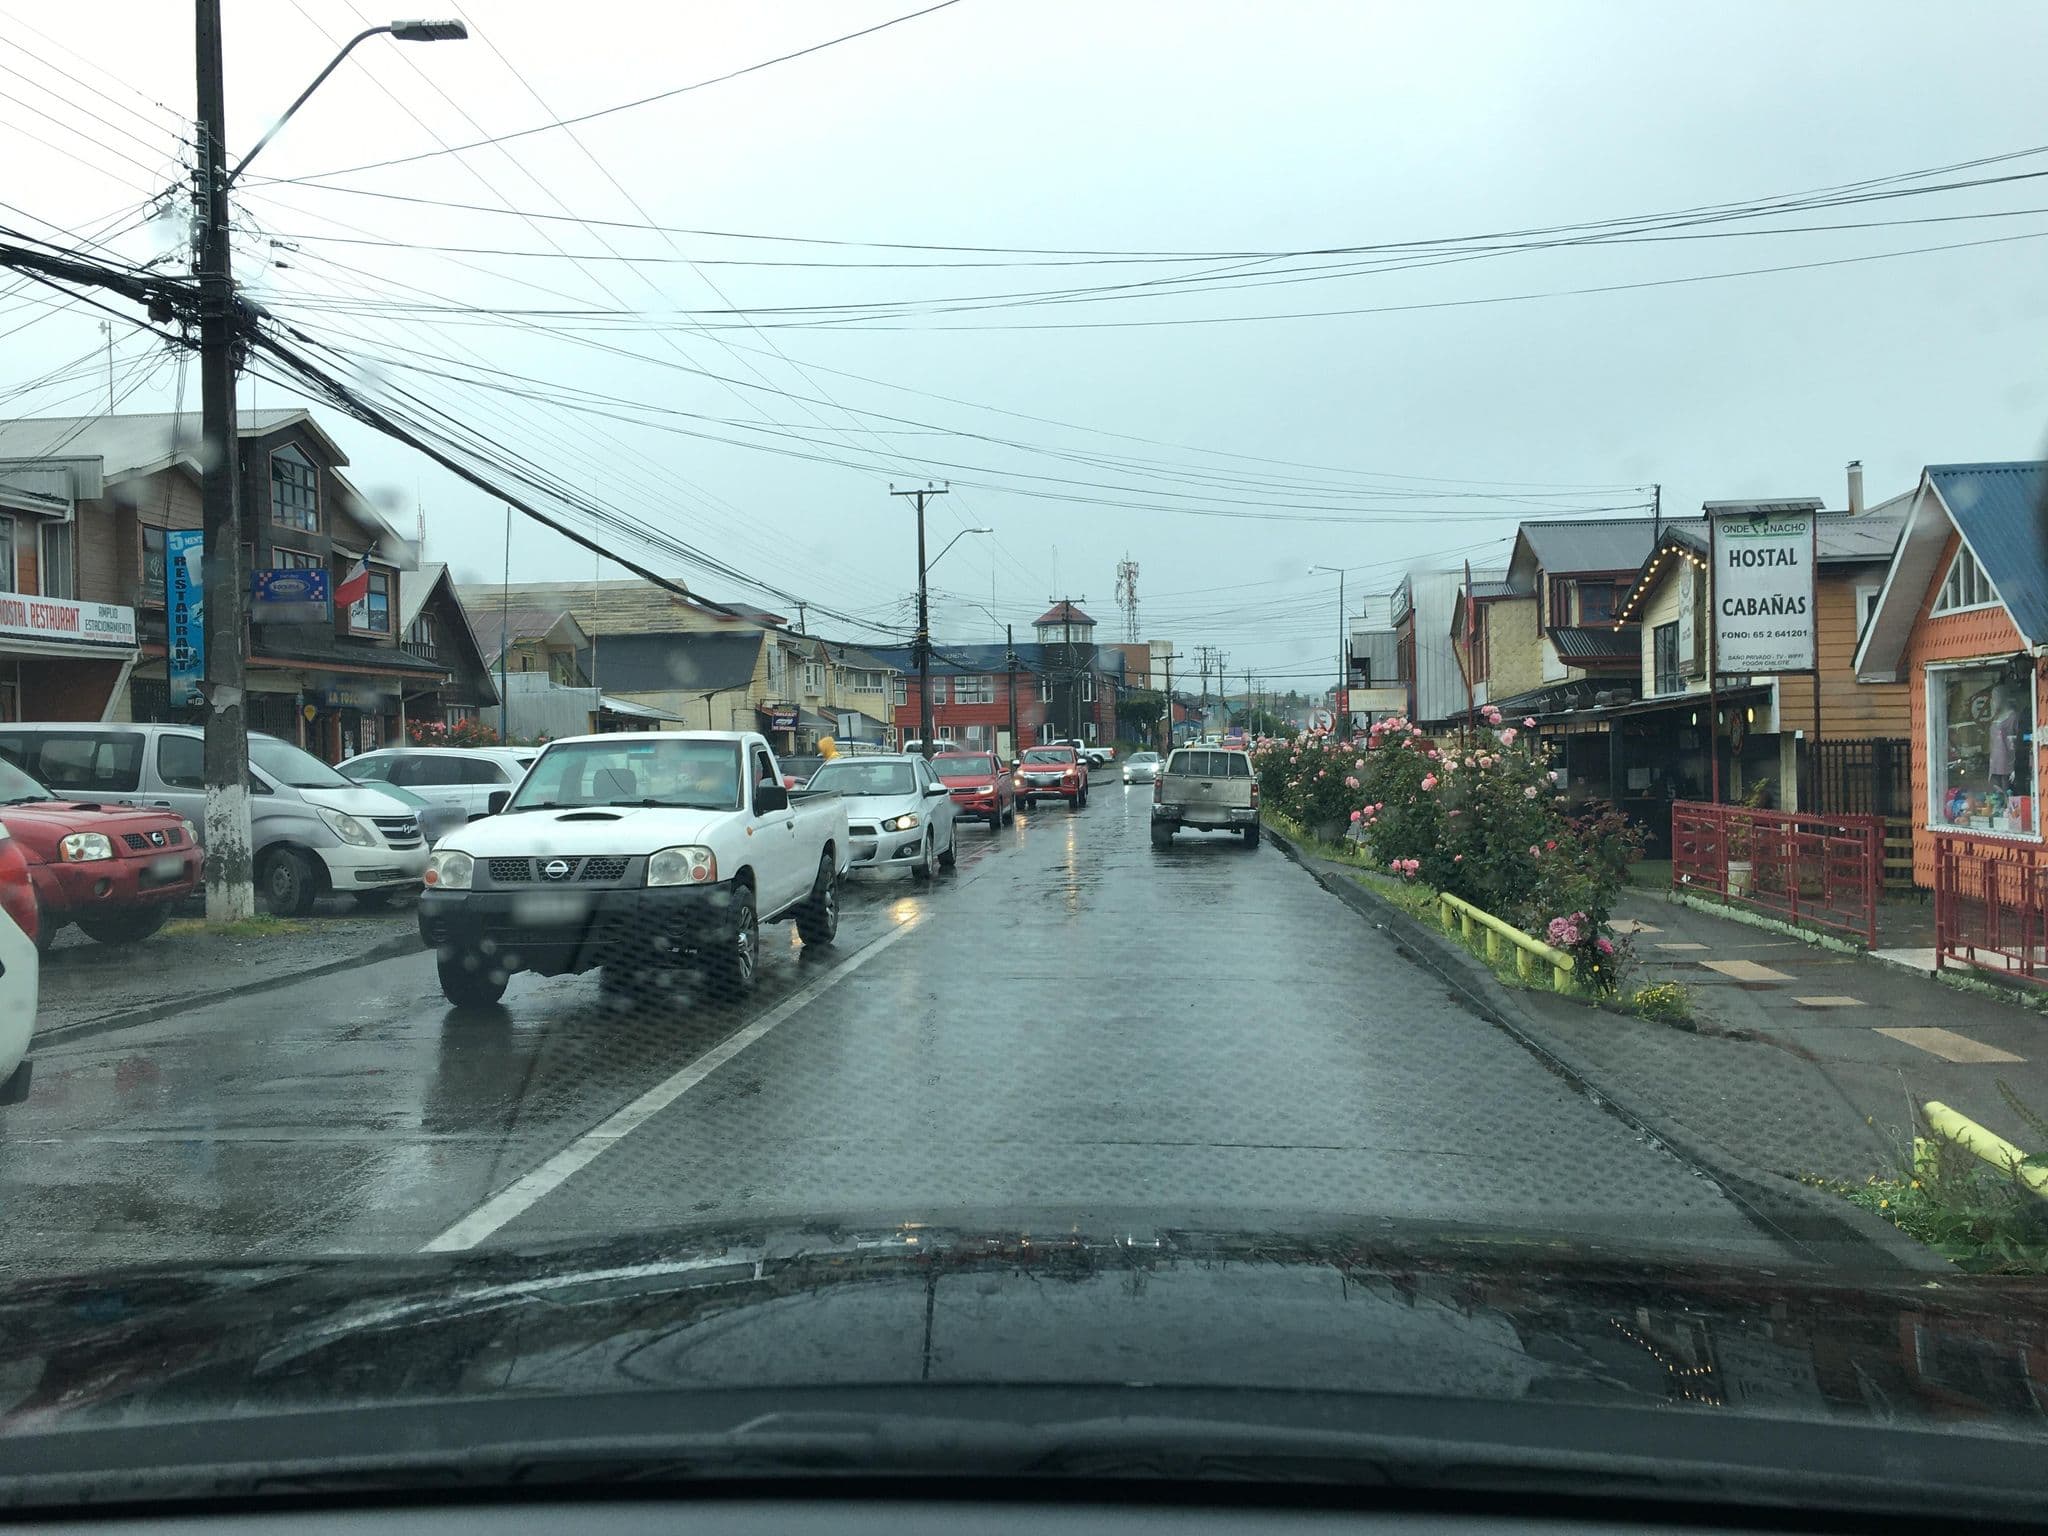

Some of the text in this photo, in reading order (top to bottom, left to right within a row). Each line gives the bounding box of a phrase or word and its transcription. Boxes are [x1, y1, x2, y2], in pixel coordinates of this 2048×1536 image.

[1770, 523, 1806, 532] NACHO
[1729, 547, 1798, 568] HOSTAL
[174, 556, 188, 671] RESTAURANT
[1722, 593, 1806, 617] CABAÑAS
[30, 602, 80, 632] RESTAURANT
[1721, 631, 1750, 639] FONO:
[1752, 631, 1764, 639] 65
[1766, 630, 1773, 638] 2
